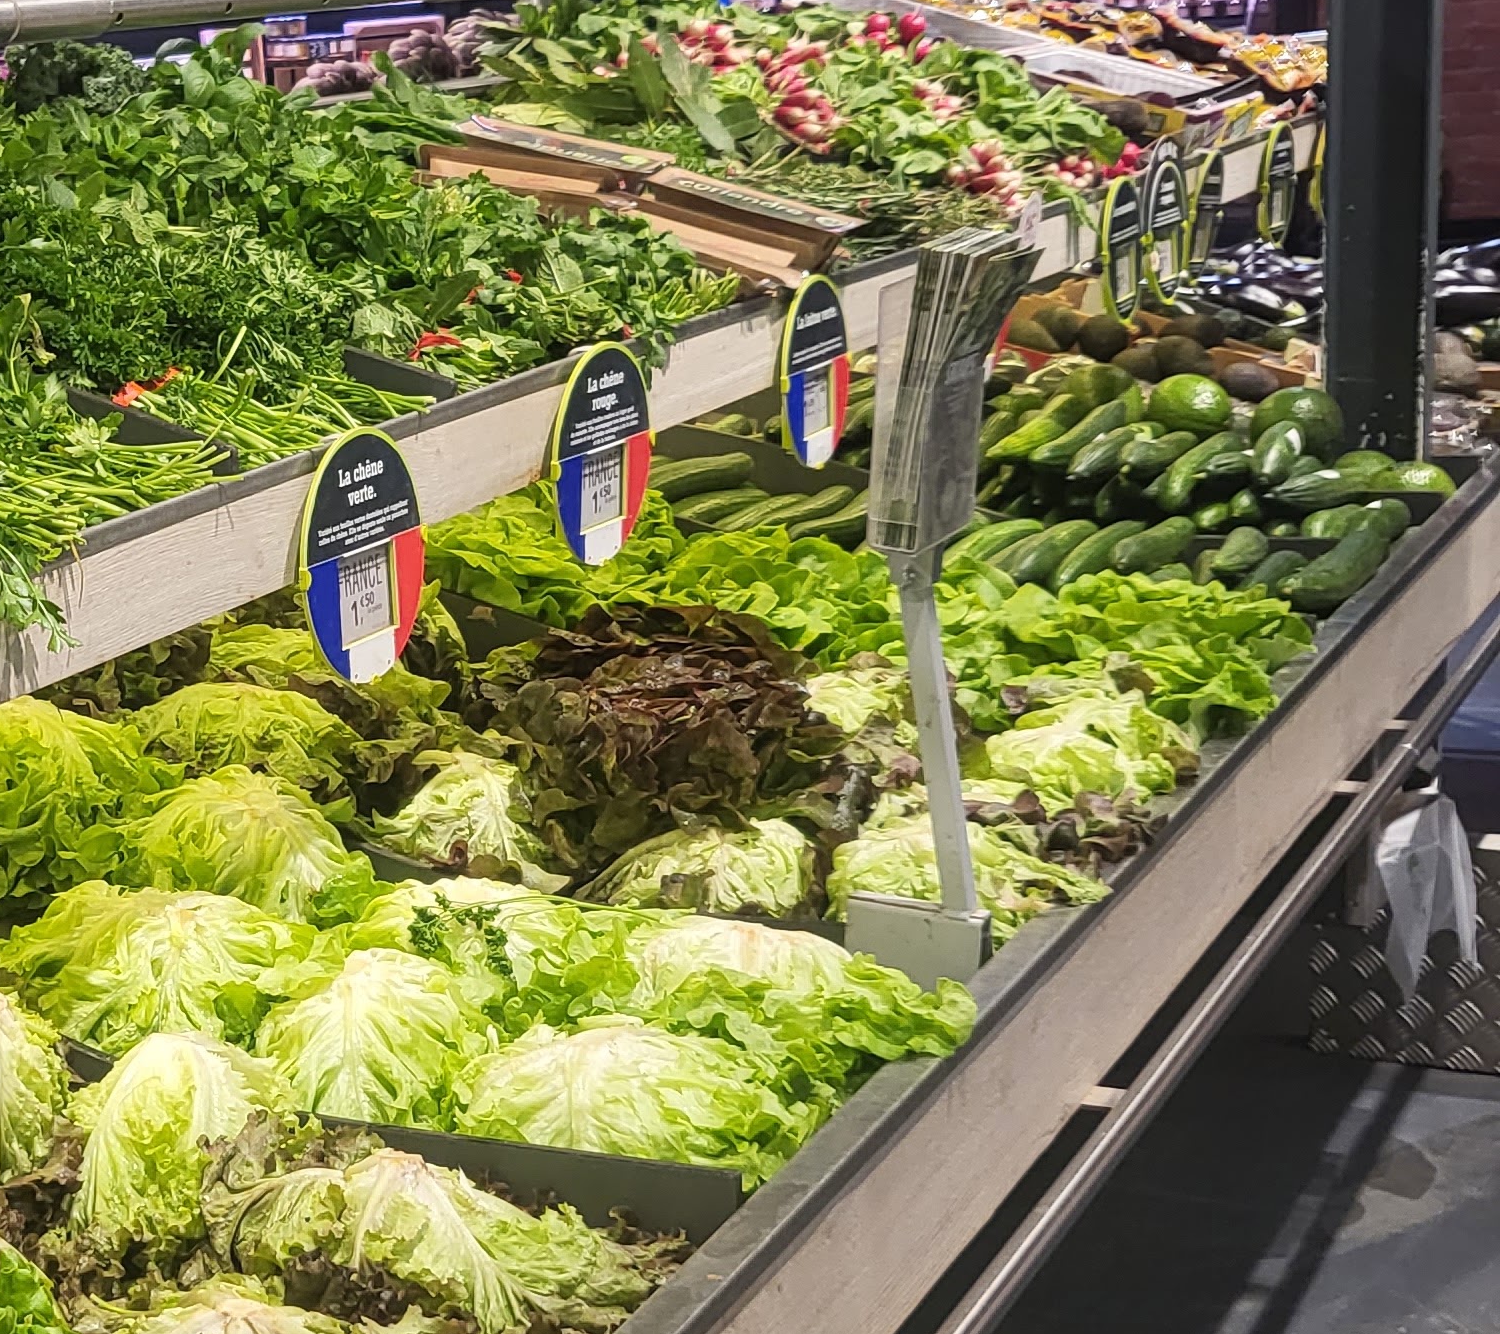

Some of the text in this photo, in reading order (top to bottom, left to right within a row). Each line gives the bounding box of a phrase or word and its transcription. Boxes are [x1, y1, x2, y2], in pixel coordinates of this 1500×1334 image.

[586, 376, 598, 394] La
[338, 458, 384, 488] La chêne
[347, 484, 378, 507] verte.
